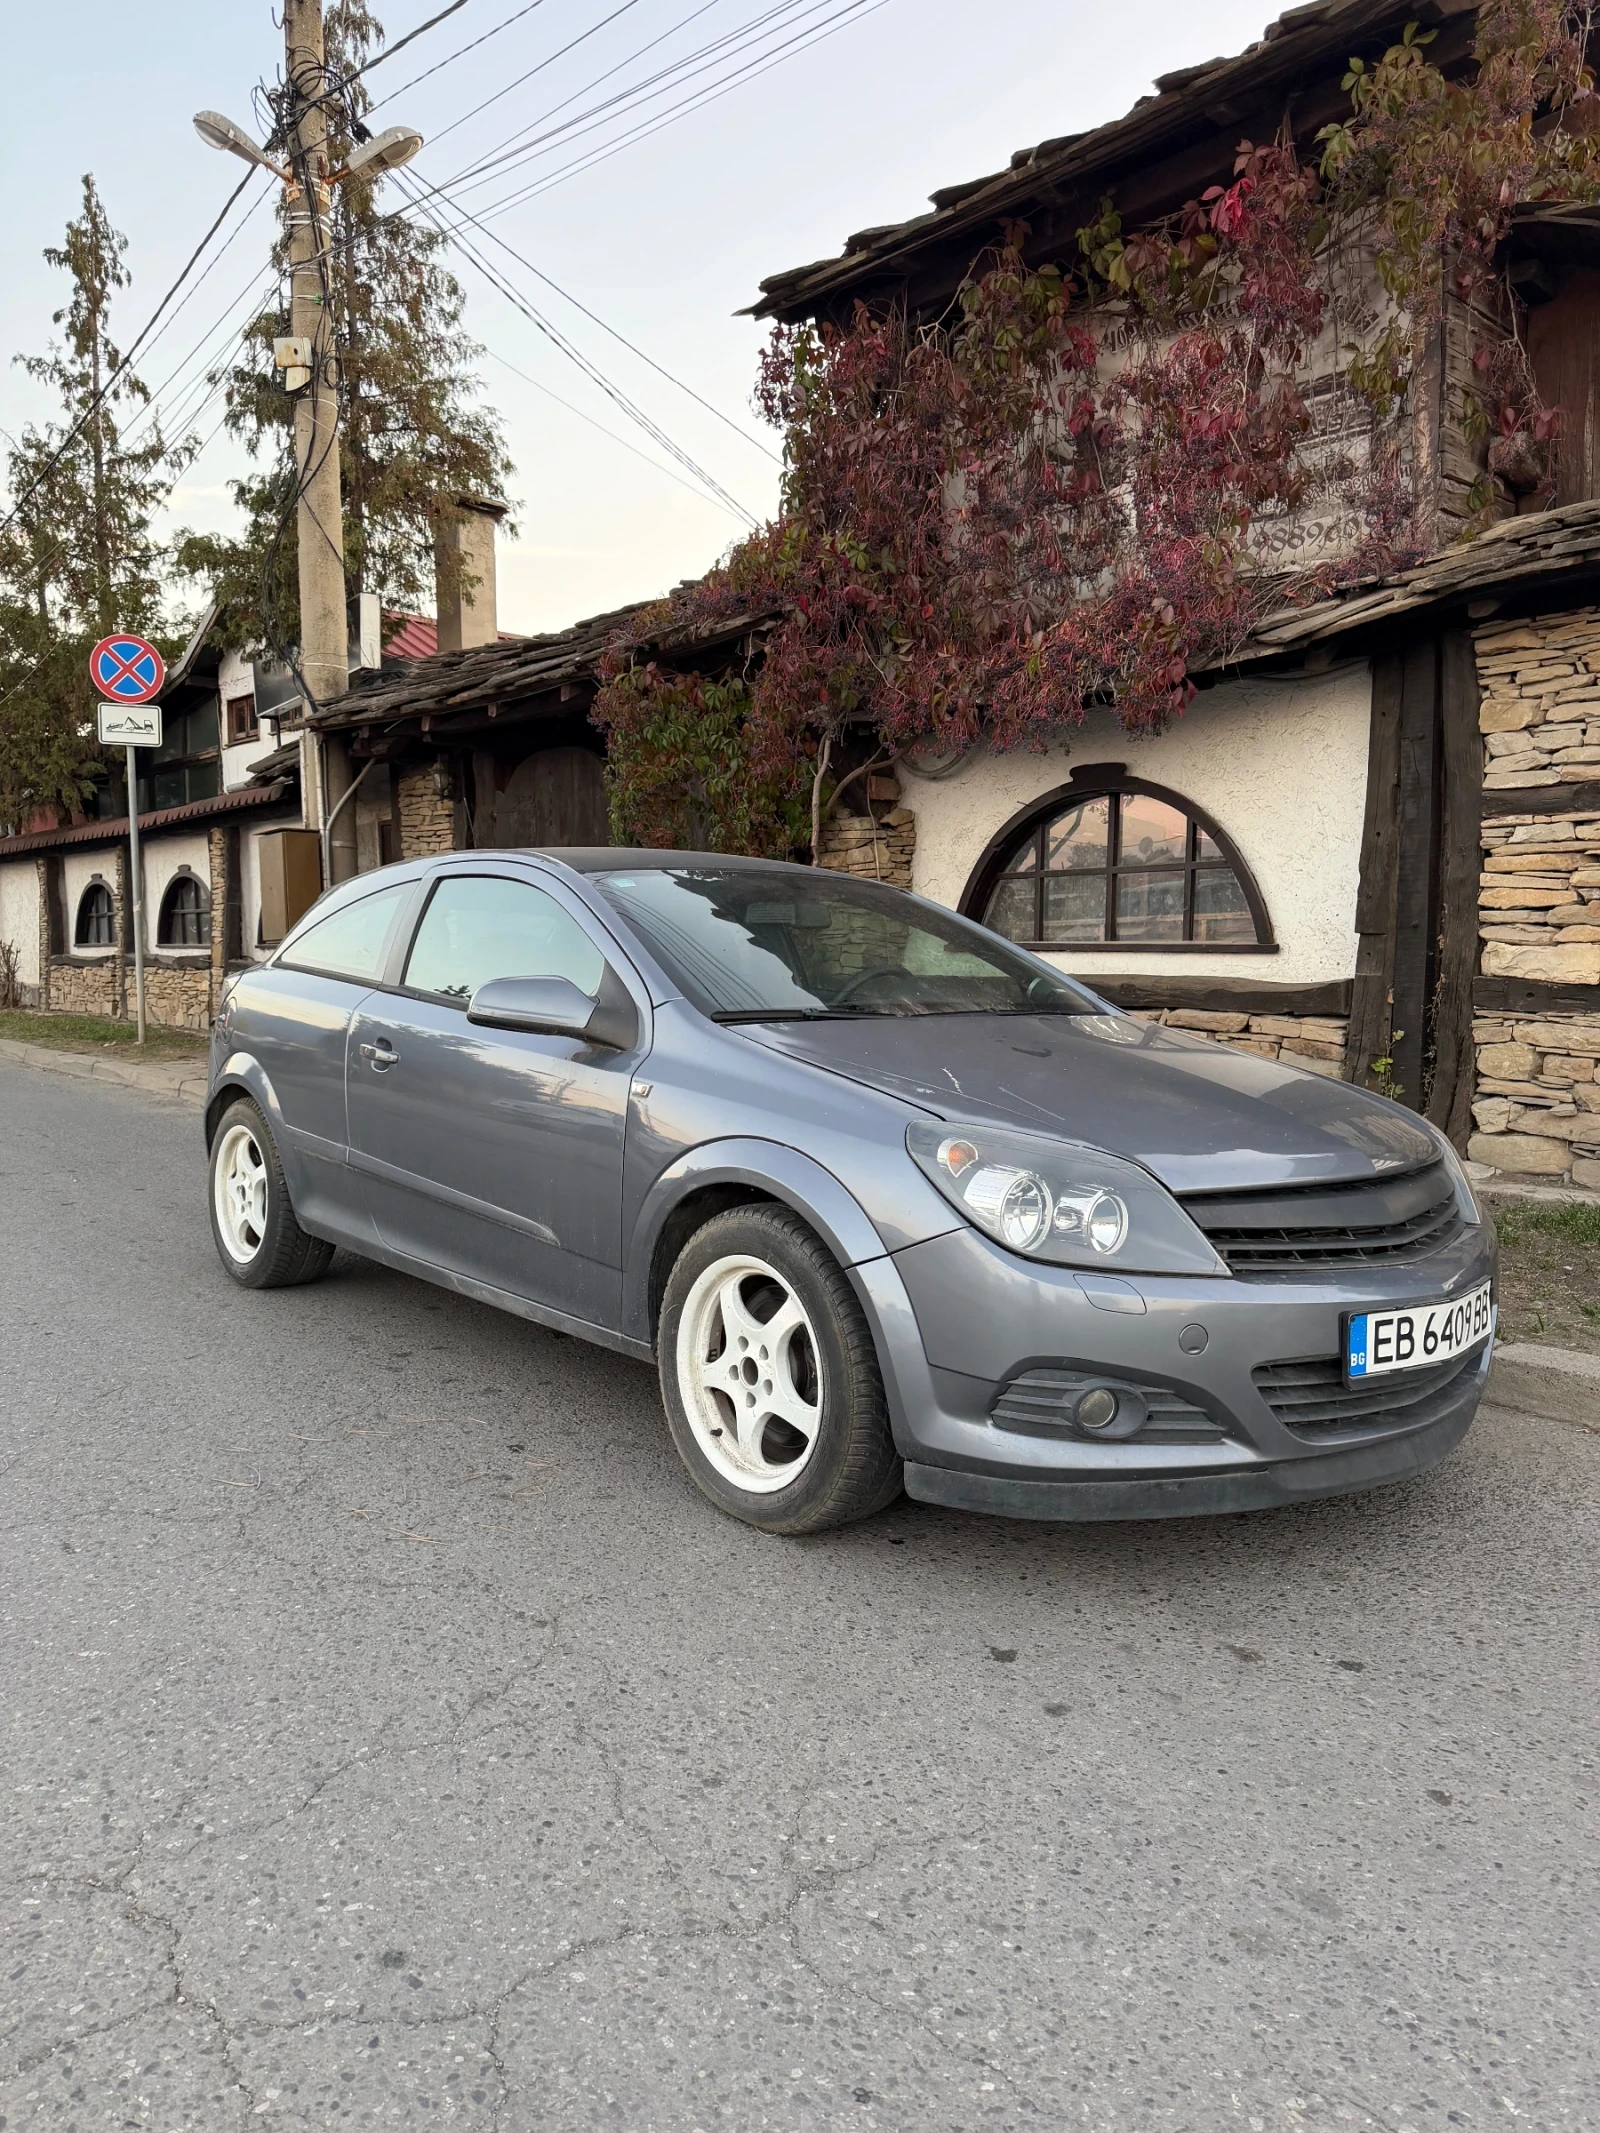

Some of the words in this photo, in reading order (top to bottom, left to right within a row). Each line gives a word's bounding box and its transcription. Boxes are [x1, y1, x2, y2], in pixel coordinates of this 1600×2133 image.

[1373, 1316, 1415, 1364] EB
[1423, 1301, 1472, 1355] 6409
[1473, 1289, 1489, 1336] BB
[1350, 1352, 1366, 1367] BG
